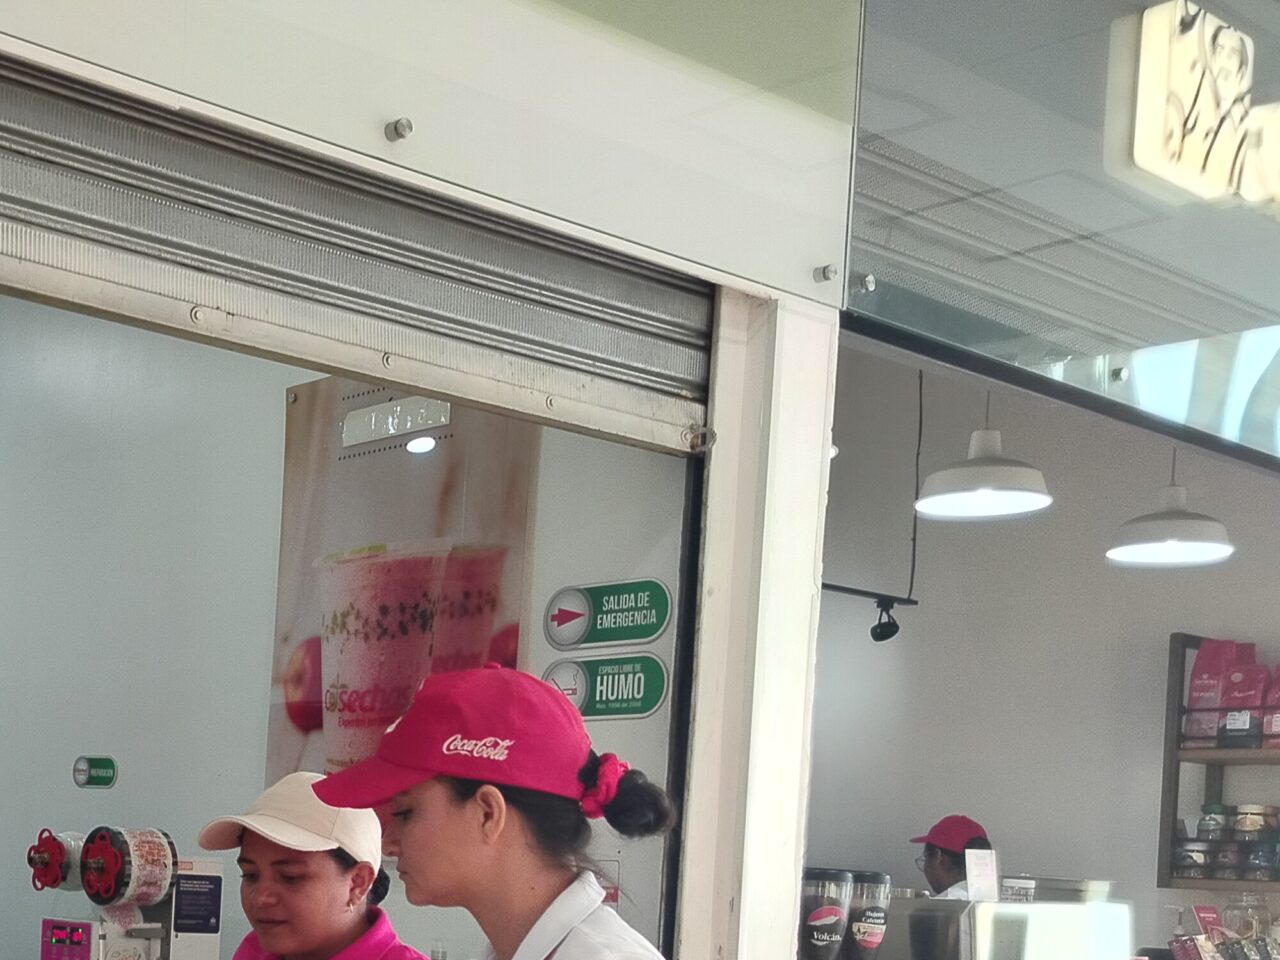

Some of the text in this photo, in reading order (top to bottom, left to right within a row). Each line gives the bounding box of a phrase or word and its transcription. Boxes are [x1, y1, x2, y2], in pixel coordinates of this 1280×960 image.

[603, 592, 650, 611] SALIDA DE
[597, 609, 656, 629] EMERGENCIA
[596, 673, 644, 700] HUMO
